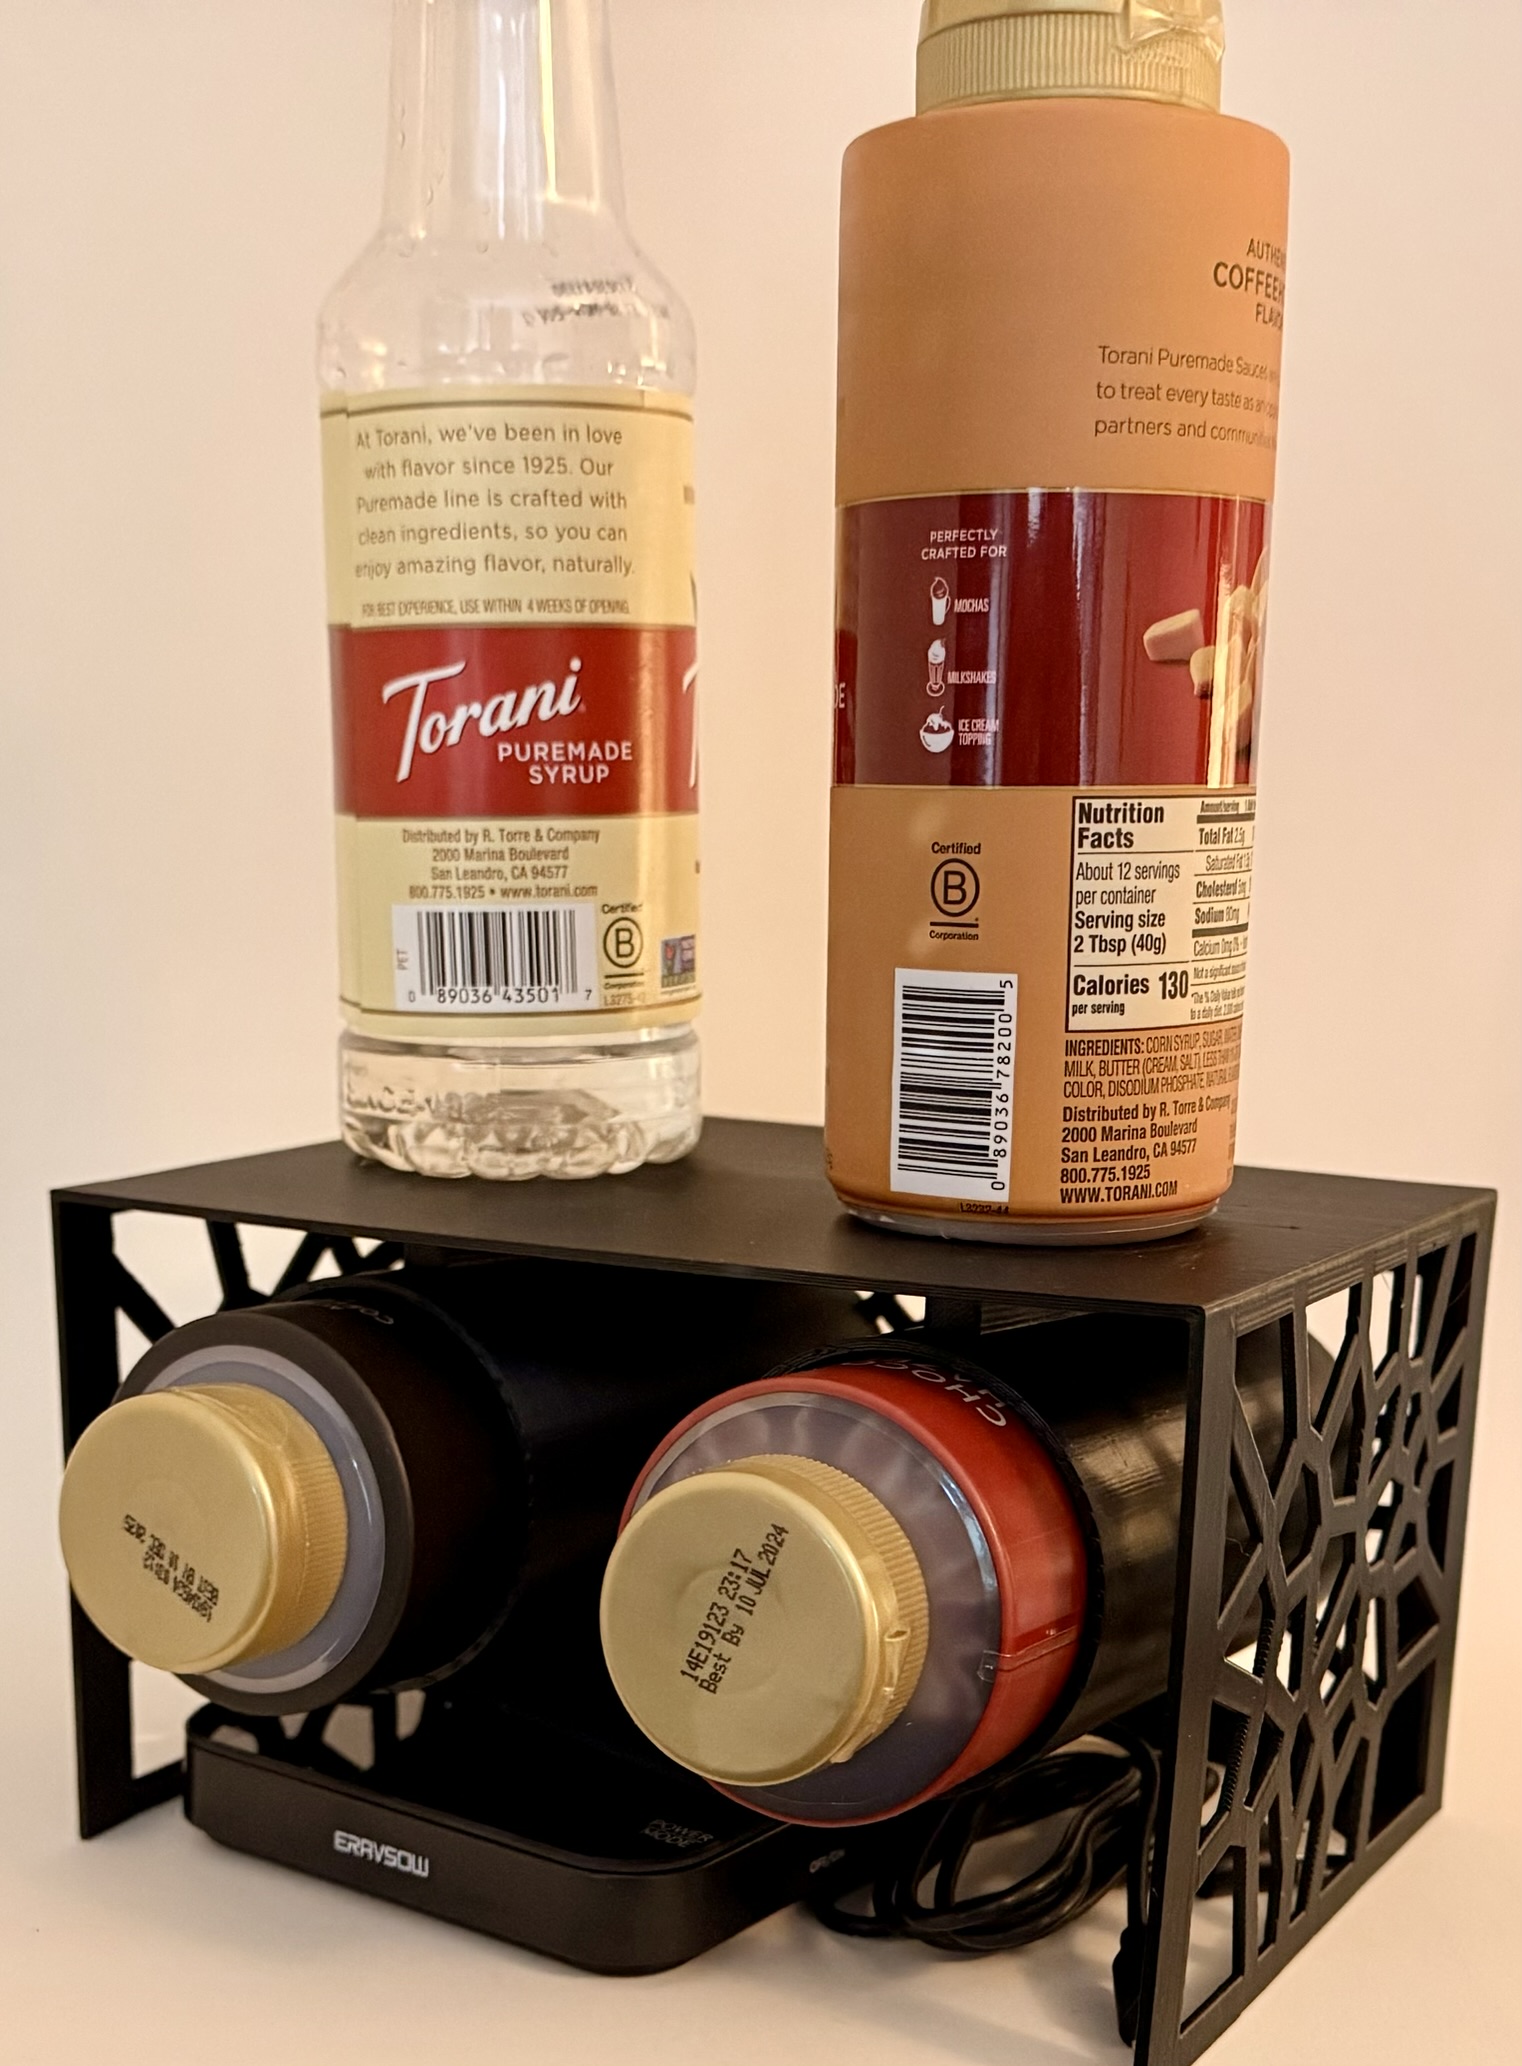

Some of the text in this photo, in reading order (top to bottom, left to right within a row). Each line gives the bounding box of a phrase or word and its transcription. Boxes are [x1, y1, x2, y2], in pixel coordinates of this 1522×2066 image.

[1098, 345, 1153, 365] Torani
[1158, 347, 1234, 373] Puremade
[1096, 381, 1116, 400] to
[1120, 382, 1162, 401] treat
[1166, 387, 1209, 408] every
[1211, 389, 1242, 408] taste
[357, 423, 623, 449] At Torani, we've been in love
[1094, 417, 1172, 437] partners
[1177, 421, 1207, 438] and
[364, 456, 614, 480] with flavor since 1925. Our
[356, 488, 628, 514] Puremade line is crafted with
[358, 522, 628, 546] clean ingredients, so you can
[930, 528, 999, 543] PERFECTLY
[921, 545, 1007, 560] CRAFTED FOR
[355, 554, 635, 579] enjoy amazing flavor, naturally.
[459, 599, 481, 615] USE
[483, 598, 522, 614] WITHIN
[527, 598, 533, 613] 4
[536, 598, 573, 614] WEEKS
[574, 598, 588, 614] OF
[953, 598, 990, 613] MOCHAS
[947, 671, 997, 684] MILKSHAKES
[381, 655, 582, 784] Torani
[958, 718, 1000, 733] ICE CREAM
[958, 732, 992, 746] TOPPING
[497, 740, 633, 763] PUREMADE
[528, 764, 610, 785] SYRUP
[1078, 802, 1165, 824] Nutrition
[402, 828, 600, 846] Distributed by R. Torre & Company
[931, 841, 981, 854] Certified
[1077, 827, 1135, 850] Facts
[1199, 828, 1221, 846] Total
[1221, 827, 1234, 844] Fat
[432, 847, 569, 862] 2000 Marina Boulevard
[431, 865, 568, 883] San Leandro, CA 94577
[1076, 860, 1181, 883] About 12 servings
[408, 884, 598, 899] 800.775.1925 www.torani.com
[1075, 886, 1157, 908] per container
[1074, 909, 1166, 932] Serving size
[1194, 906, 1225, 924] Sodium
[929, 930, 979, 941] Corporation
[1073, 932, 1167, 957] 2 Tbsp (40g)
[408, 990, 416, 1003] 0
[436, 988, 493, 1004] 89036
[502, 987, 559, 1004] 43501
[584, 989, 592, 1001] 7
[1073, 973, 1150, 997] Calories
[1158, 969, 1189, 1000] 130
[1071, 1001, 1125, 1017] per serving
[1064, 1038, 1145, 1057] INGREDIENTS:
[1145, 1035, 1173, 1054] CORN
[1173, 1033, 1201, 1052] SYRUP,
[1064, 1060, 1097, 1079] MILK,
[1099, 1058, 1140, 1077] BUTTER
[1142, 1055, 1179, 1079] (CREAM,
[990, 979, 1014, 1191] 0 89036 78200 5
[1063, 1081, 1106, 1100] COLOR,
[1108, 1078, 1159, 1098] DISODIUM
[1062, 1104, 1139, 1122] Distributed
[1142, 1103, 1156, 1122] by
[1159, 1101, 1170, 1117] R.
[1173, 1100, 1197, 1116] Torre
[1197, 1097, 1204, 1113] &
[1062, 1118, 1198, 1143] 2000 Marina Boulevard
[1060, 1138, 1197, 1164] San Leandro, CA 94577
[1060, 1164, 1151, 1184] 800.775.1925
[1060, 1180, 1178, 1204] WWW.TORANI.COM
[680, 1548, 752, 1683] 14E19123 23:17
[698, 1523, 790, 1695] Best By 10 JUL 2024
